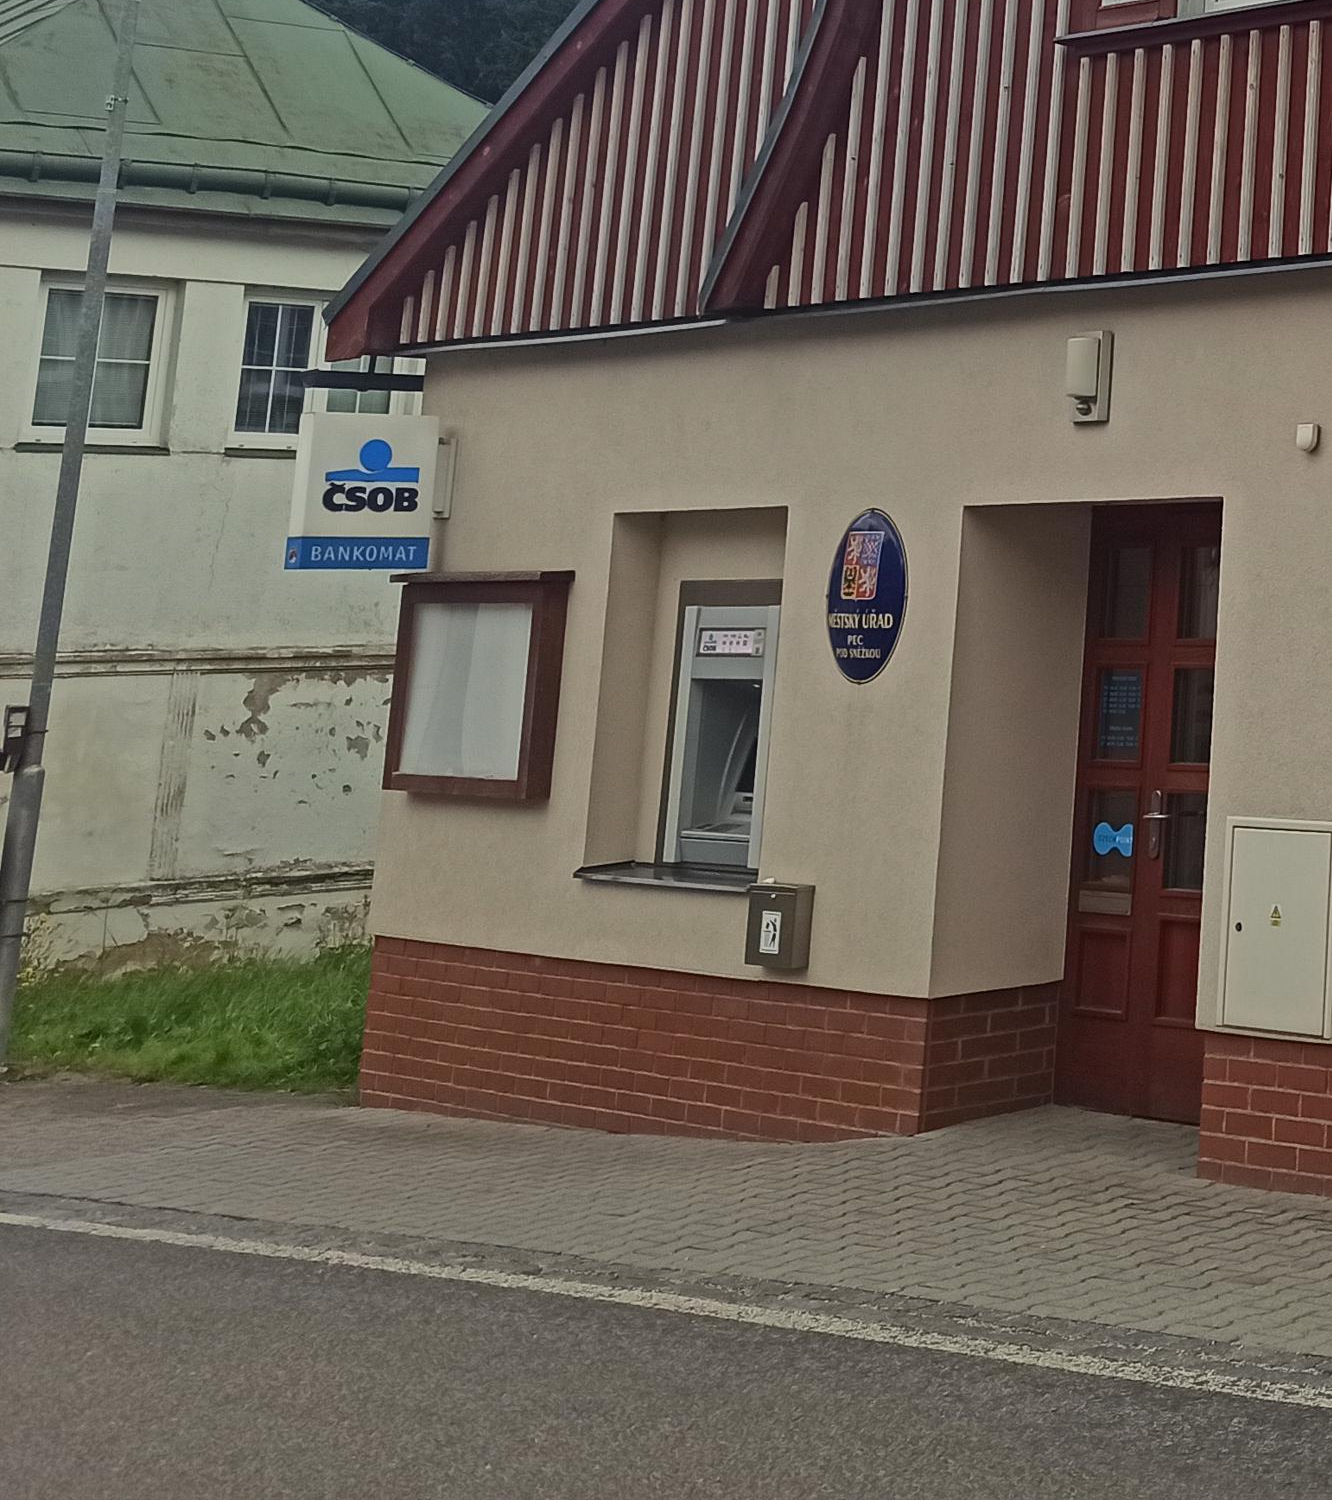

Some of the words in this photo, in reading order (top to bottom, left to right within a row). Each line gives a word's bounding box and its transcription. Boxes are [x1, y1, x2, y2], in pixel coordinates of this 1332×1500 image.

[322, 482, 419, 512] ČSOB
[310, 546, 417, 561] BANKOMAT
[847, 634, 864, 645] PEC
